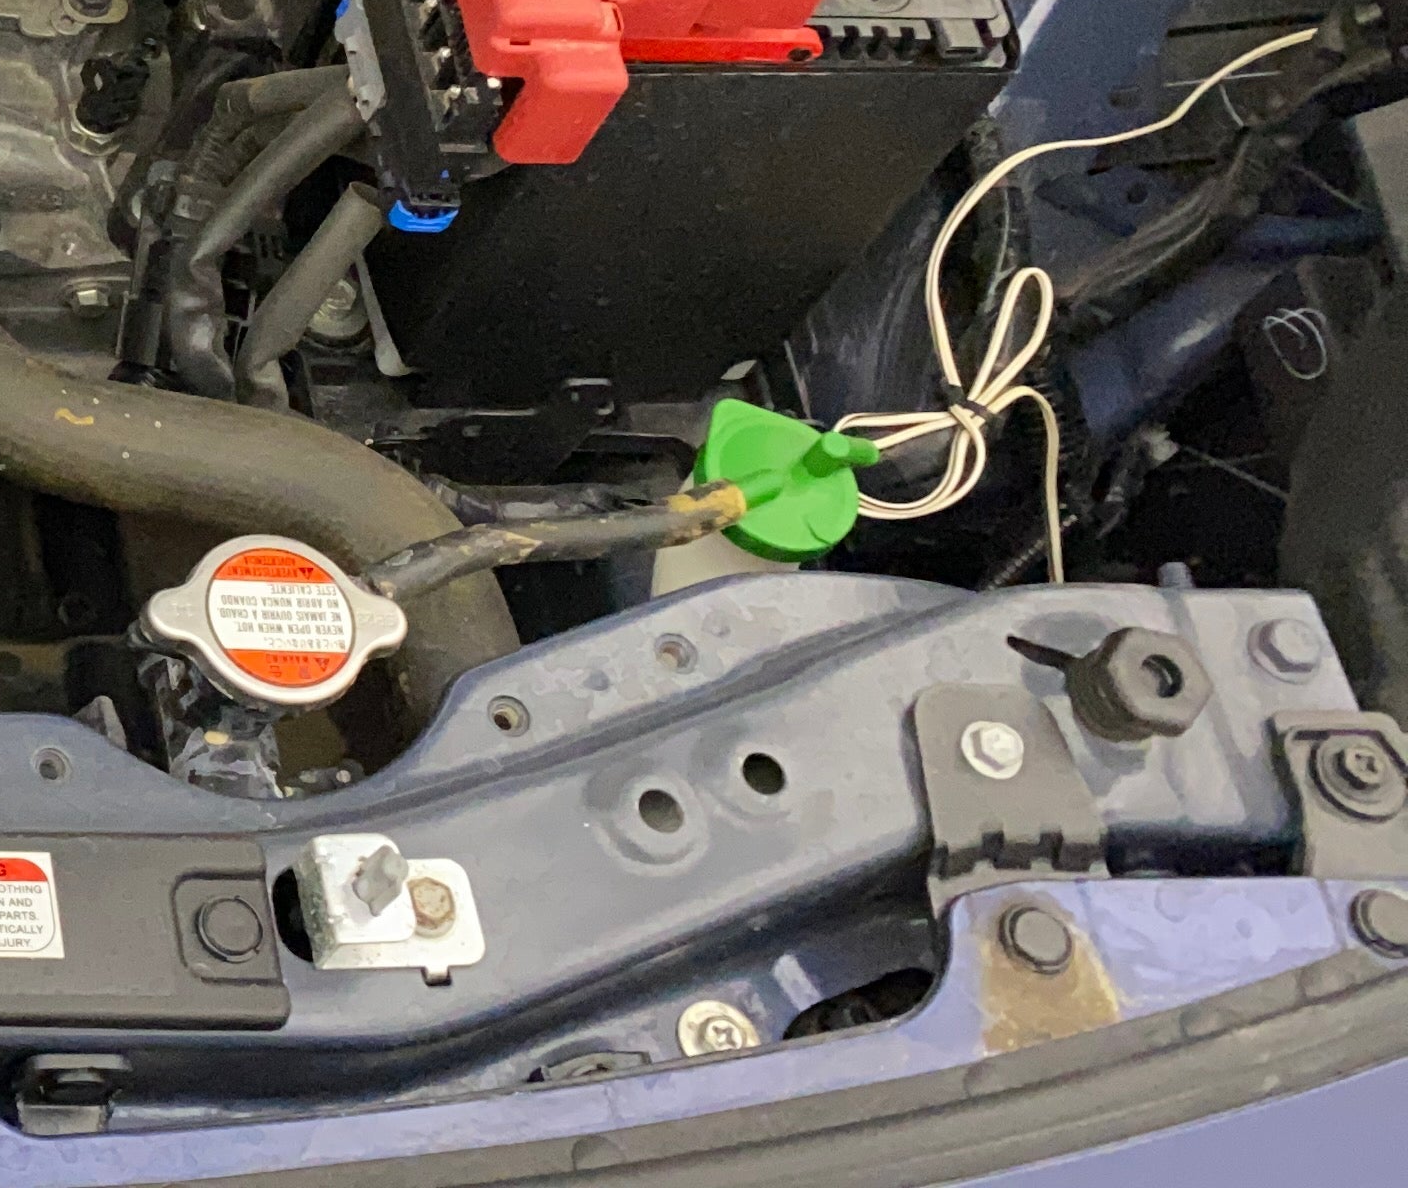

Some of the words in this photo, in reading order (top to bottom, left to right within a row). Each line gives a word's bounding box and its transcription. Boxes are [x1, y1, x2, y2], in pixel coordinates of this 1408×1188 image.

[316, 586, 337, 596] ESTE
[221, 595, 257, 606] CUANDO
[261, 596, 292, 607] NUNCA
[296, 597, 323, 608] ABRIR
[327, 599, 339, 609] NO
[261, 610, 293, 621] OUVRIR
[296, 610, 327, 622] JAMAIS
[330, 612, 342, 622] NE
[258, 622, 284, 634] WHEN
[287, 623, 311, 635] OPEN
[315, 624, 344, 635] NEVER
[8, 897, 33, 907] AND
